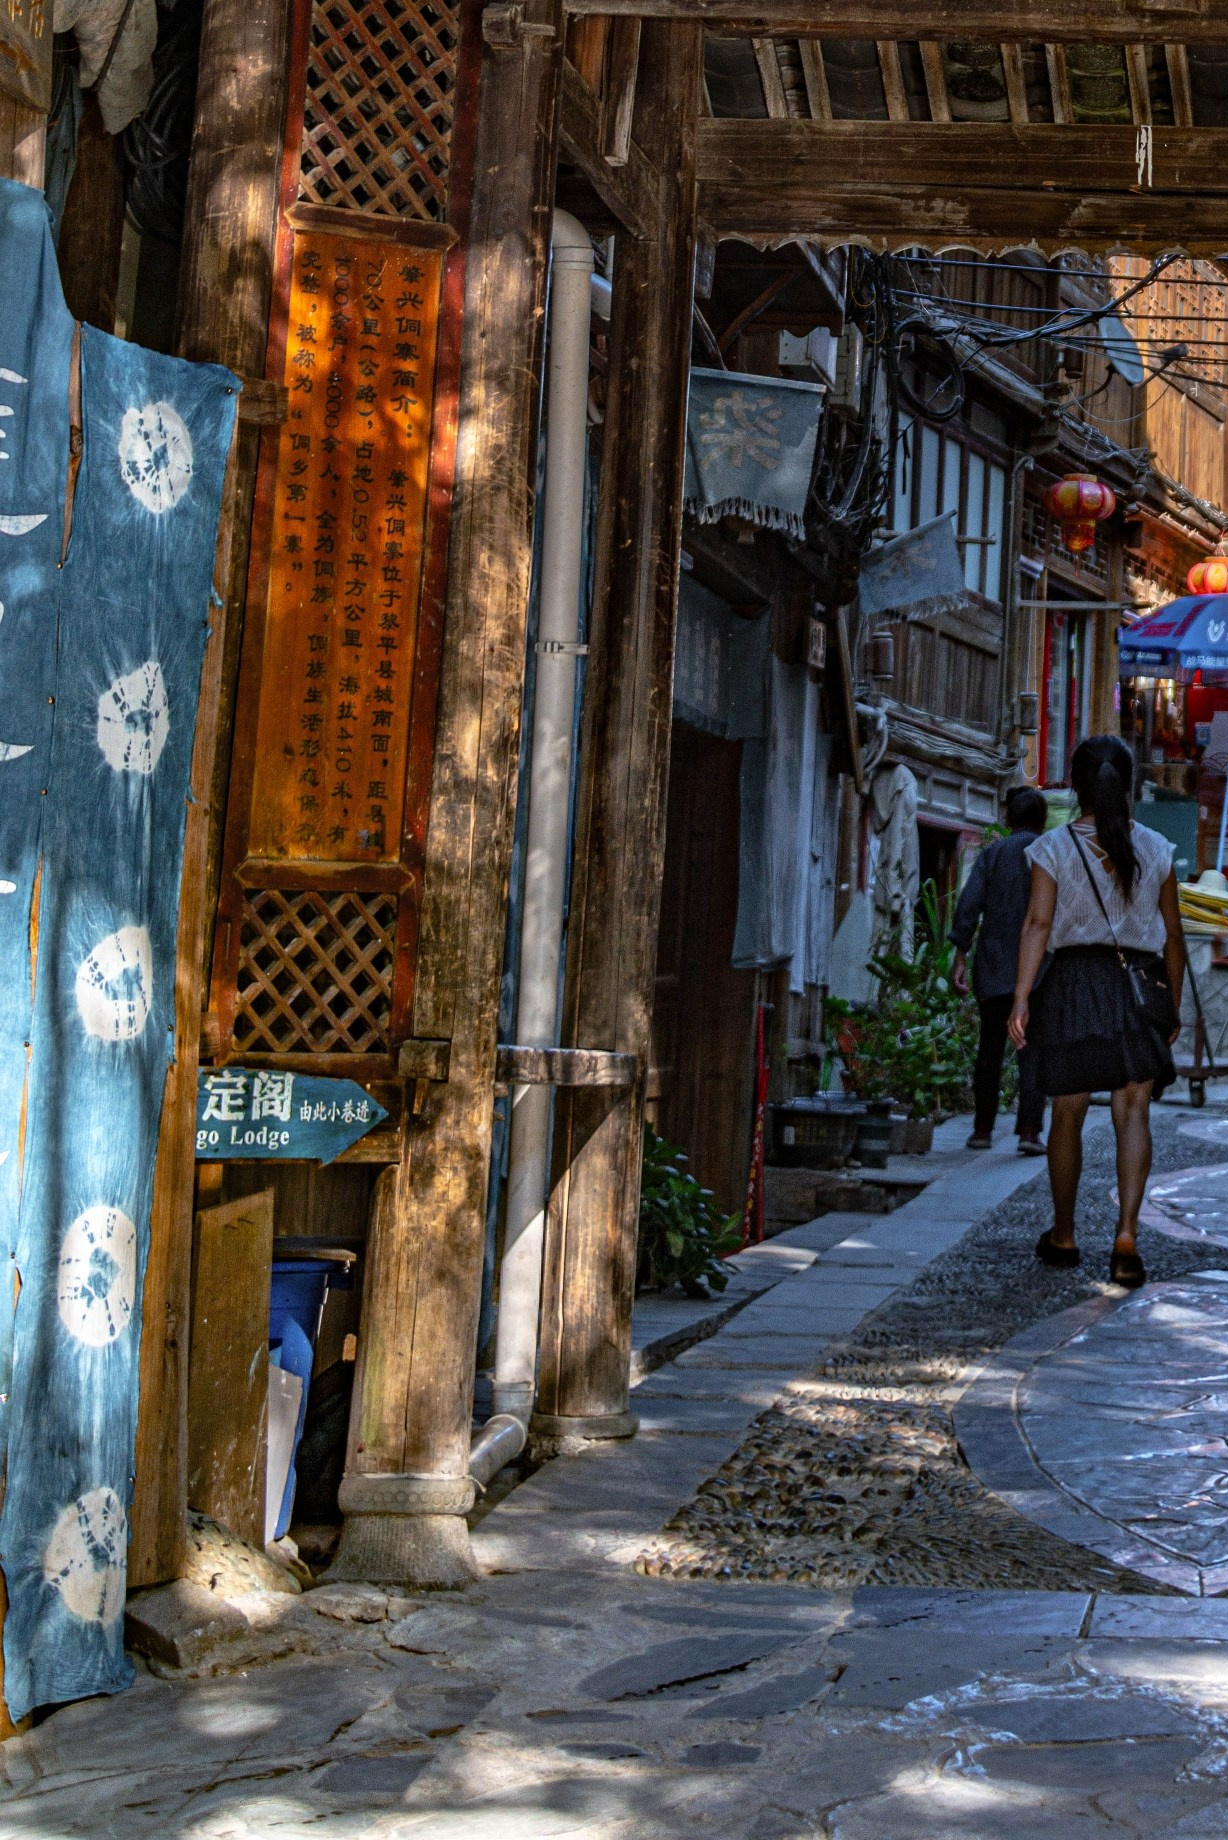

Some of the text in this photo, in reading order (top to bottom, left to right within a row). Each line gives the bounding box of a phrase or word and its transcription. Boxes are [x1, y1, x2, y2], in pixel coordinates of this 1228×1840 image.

[300, 1099, 371, 1123] 由此小巷进
[230, 1126, 290, 1150] Lodge
